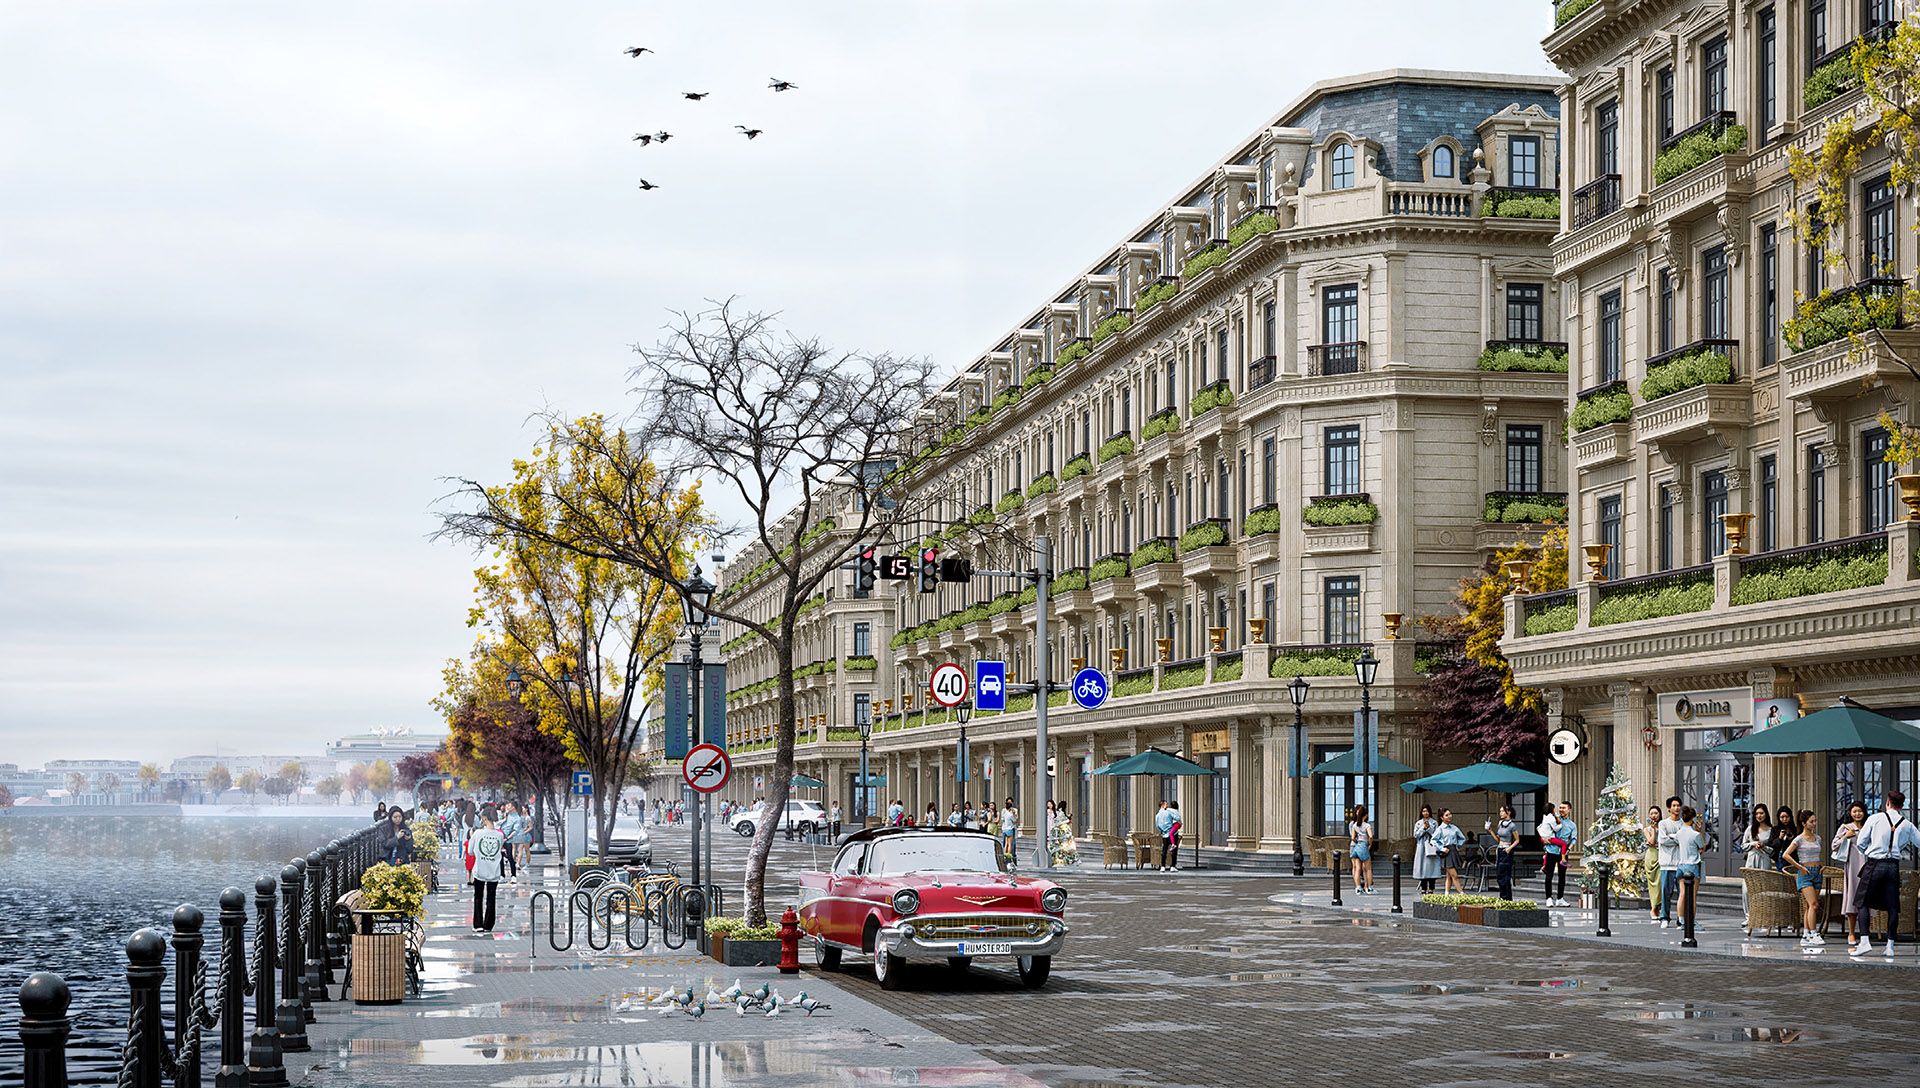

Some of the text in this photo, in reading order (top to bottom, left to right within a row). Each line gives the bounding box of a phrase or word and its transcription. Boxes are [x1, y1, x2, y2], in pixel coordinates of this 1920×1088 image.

[891, 559, 907, 576] 15
[937, 673, 962, 697] 40
[578, 774, 592, 793] P
[965, 943, 1010, 953] HUMSTER3D
